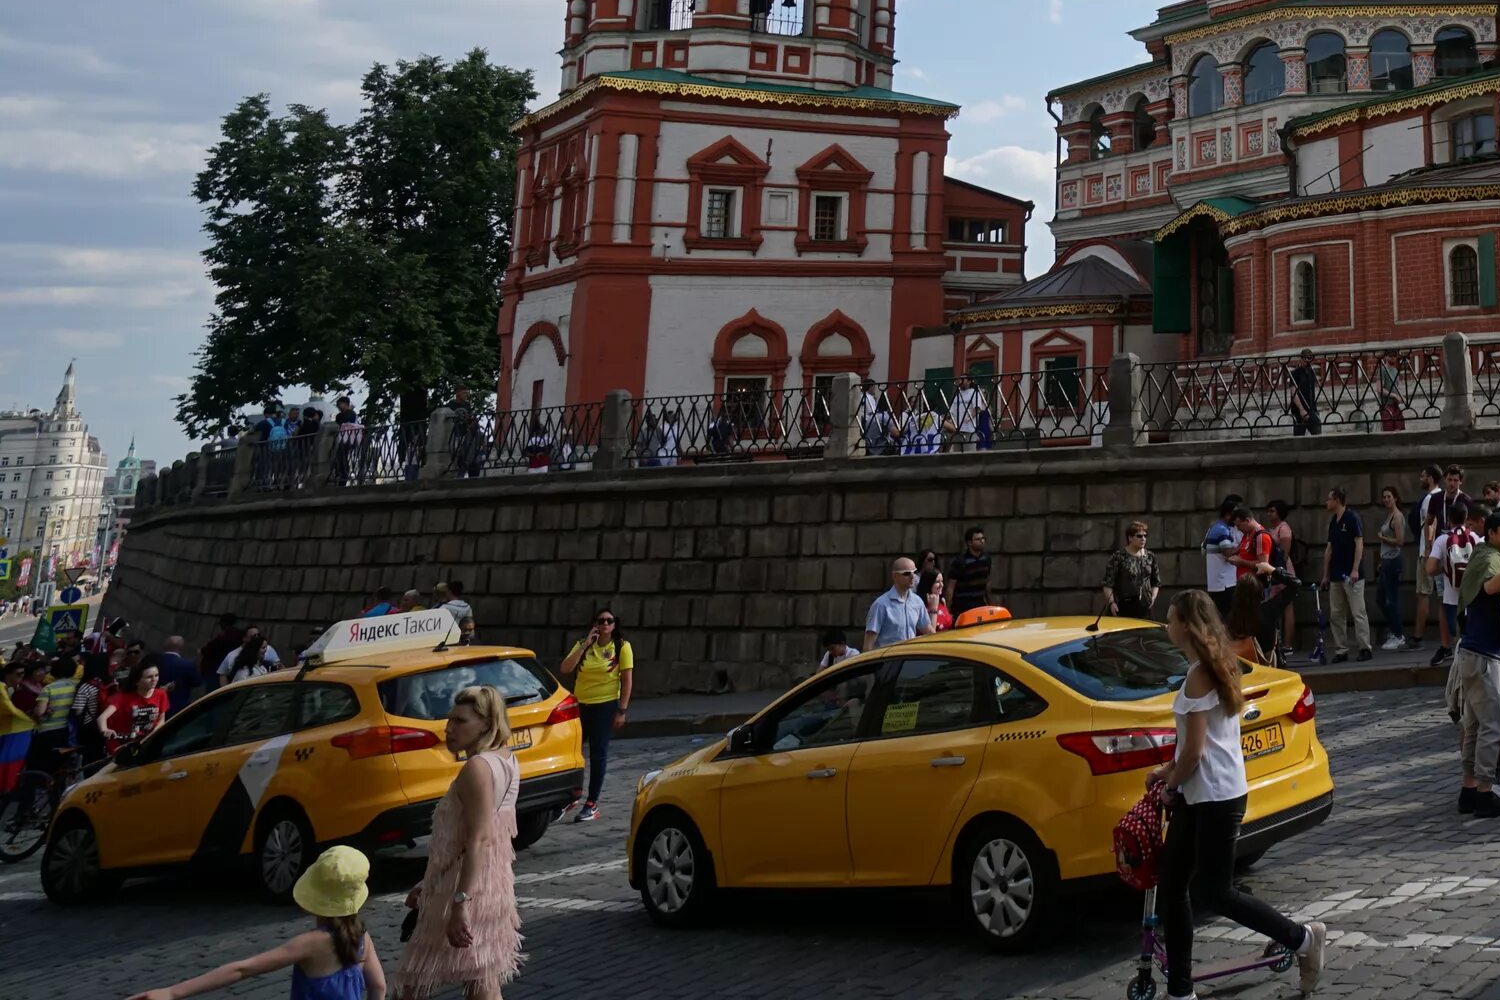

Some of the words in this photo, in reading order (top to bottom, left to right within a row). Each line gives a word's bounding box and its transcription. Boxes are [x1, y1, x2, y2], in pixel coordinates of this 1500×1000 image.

[349, 622, 400, 643] Яндекс
[404, 616, 442, 635] Такси
[1241, 733, 1263, 753] 426
[1266, 727, 1278, 741] 77
